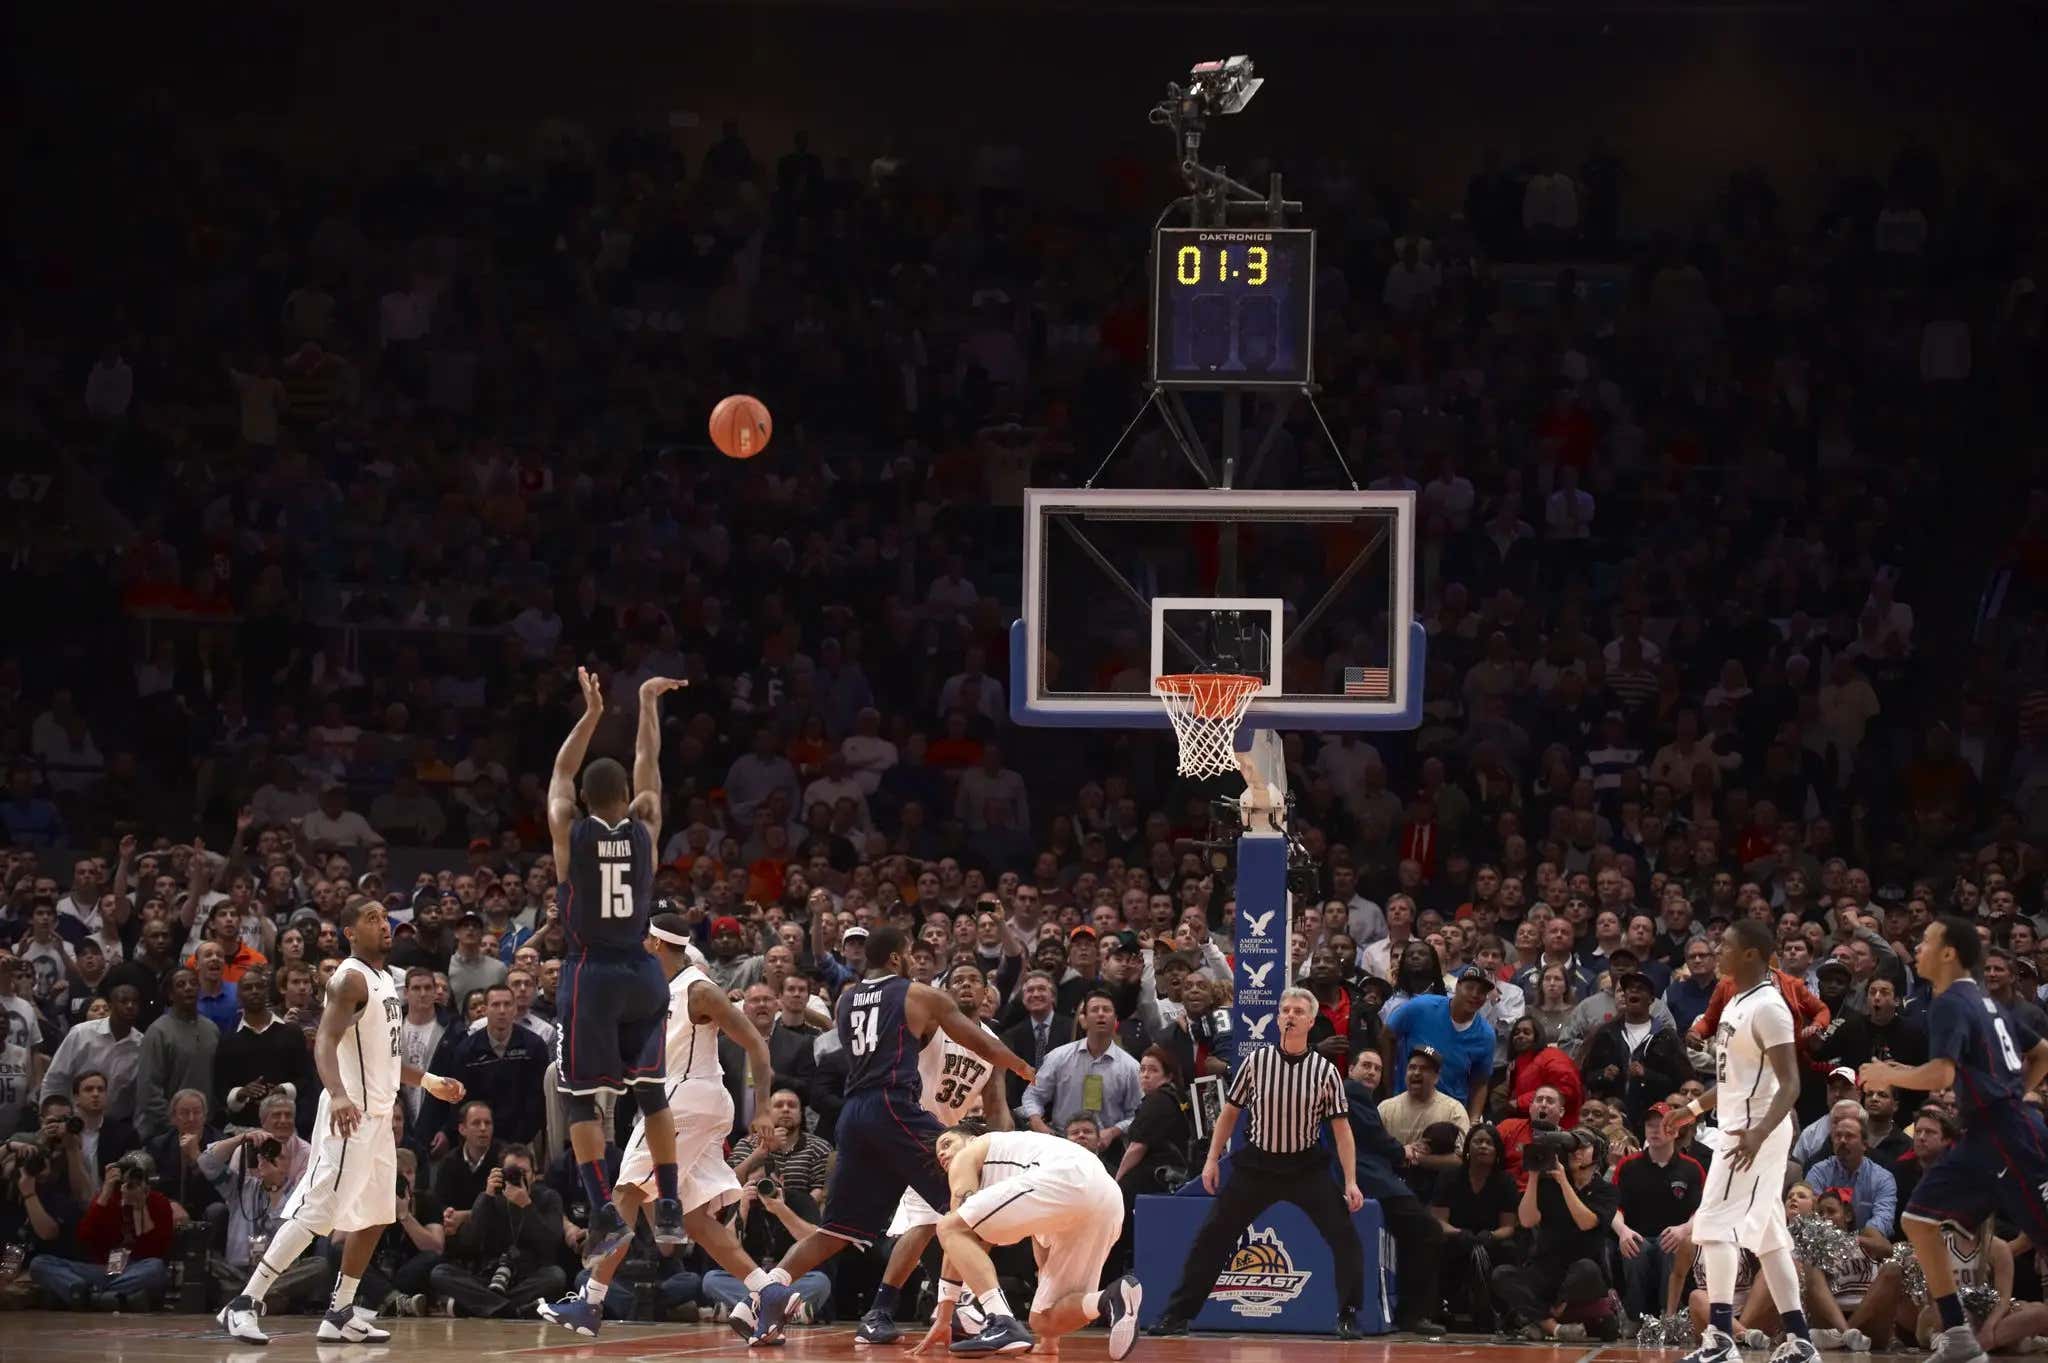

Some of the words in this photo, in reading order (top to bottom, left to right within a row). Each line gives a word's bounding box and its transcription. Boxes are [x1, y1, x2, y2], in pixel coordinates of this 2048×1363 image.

[1200, 233, 1272, 241] DAKTRONICS
[1177, 246, 1268, 285] 01.3
[598, 840, 631, 857] WALKER
[600, 863, 633, 918] 15
[850, 1006, 879, 1057] 34
[1213, 1009, 1231, 1032] 3
[943, 1053, 986, 1084] PITT
[935, 1079, 972, 1110] 35
